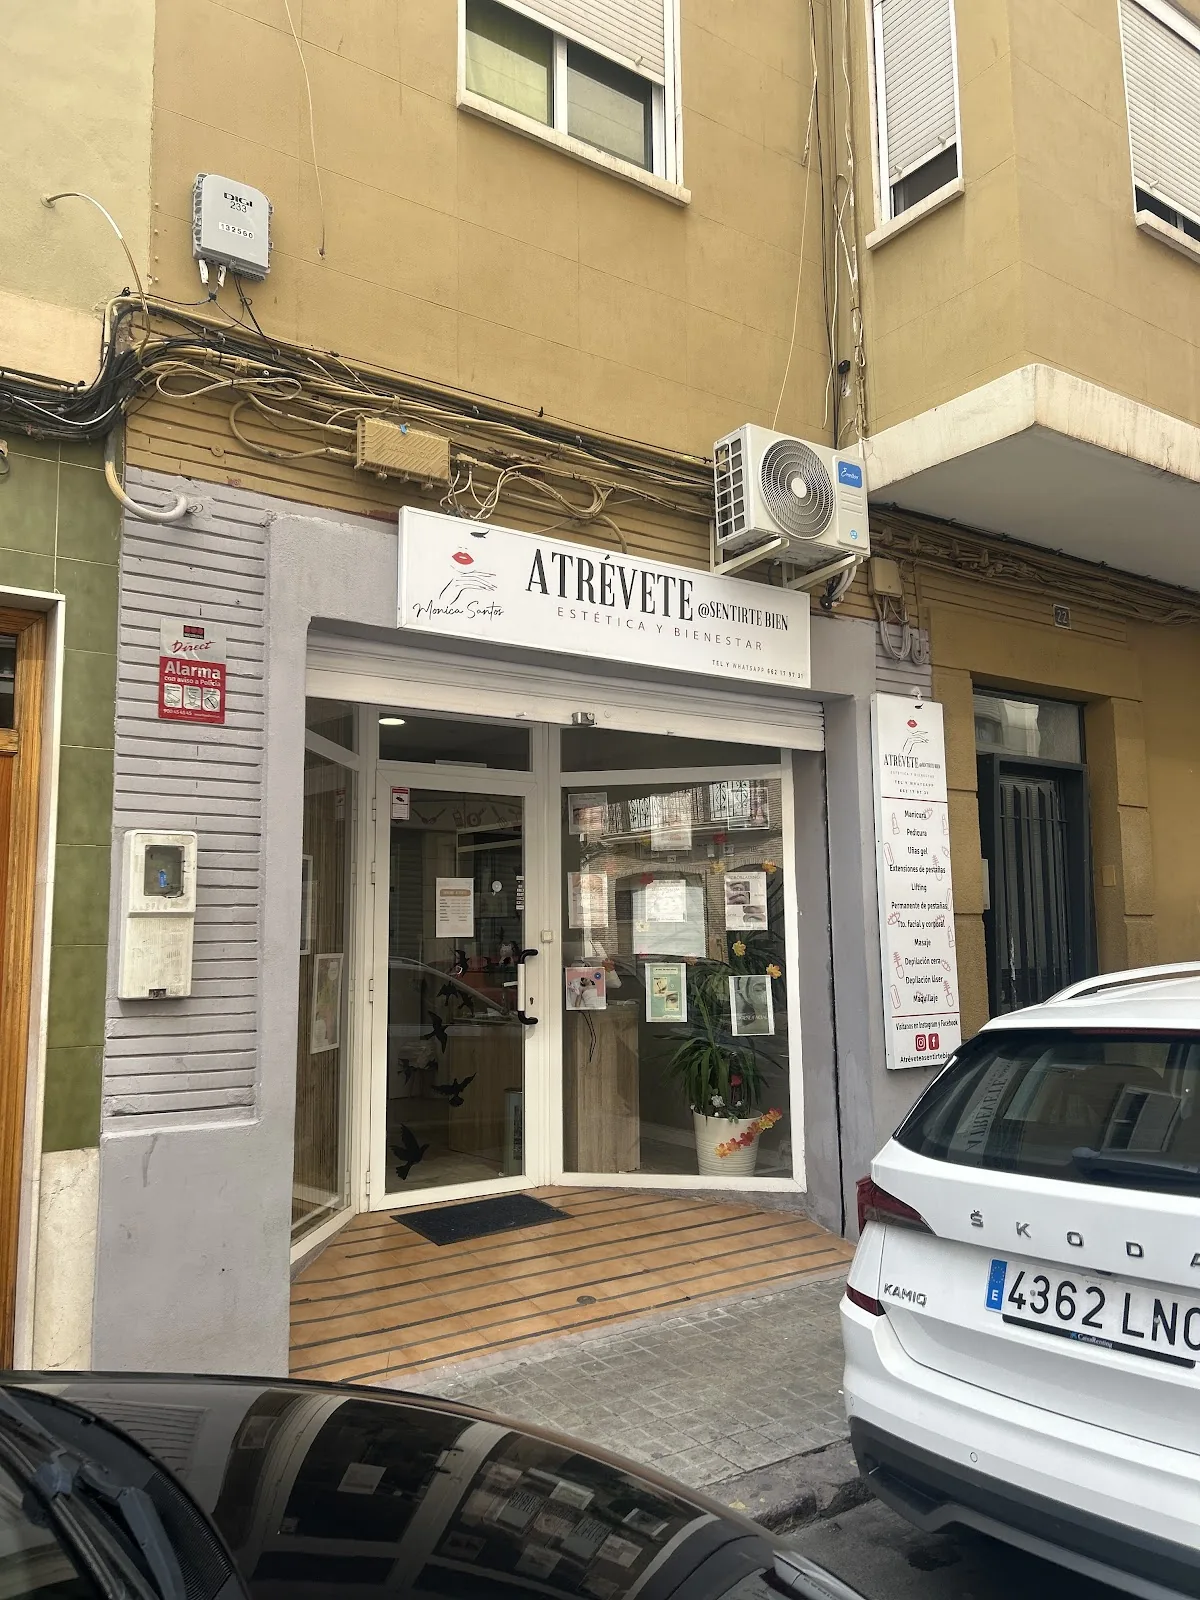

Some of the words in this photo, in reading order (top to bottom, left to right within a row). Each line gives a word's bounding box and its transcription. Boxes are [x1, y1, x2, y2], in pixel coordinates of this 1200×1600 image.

[223, 192, 253, 207] DIGI
[230, 201, 247, 213] 233
[525, 548, 693, 621] ATRÉVETE
[698, 600, 762, 627] @SENTIRTE
[765, 611, 788, 631] BIEN
[467, 601, 504, 621] Santos
[557, 606, 646, 631] ESTÉTICA
[656, 624, 663, 634] Y
[674, 627, 762, 651] BIENESTAR
[172, 640, 216, 653] Direct
[164, 661, 221, 680] Alarma
[712, 659, 723, 667] TEL
[732, 663, 765, 673] WHATSAPP
[884, 753, 919, 769] ATRÉVETE
[904, 810, 927, 819] Manicura
[906, 828, 927, 837] Pedicura
[907, 846, 920, 855] Uñas
[920, 847, 928, 857] gel
[890, 864, 918, 873] Extensiones
[919, 865, 925, 873] de
[911, 882, 927, 893] Lifting
[891, 901, 920, 910] Permanente
[920, 901, 927, 910] de
[914, 938, 932, 948] Masaje
[904, 956, 931, 968] Depilación
[905, 975, 931, 985] Depilación
[913, 994, 938, 1004] Maquillaje
[919, 1021, 937, 1030] Instagram
[940, 1019, 958, 1027] Facebook
[883, 1282, 928, 1307] KAMIQ
[991, 1289, 999, 1302] E
[1007, 1269, 1106, 1330] 4362
